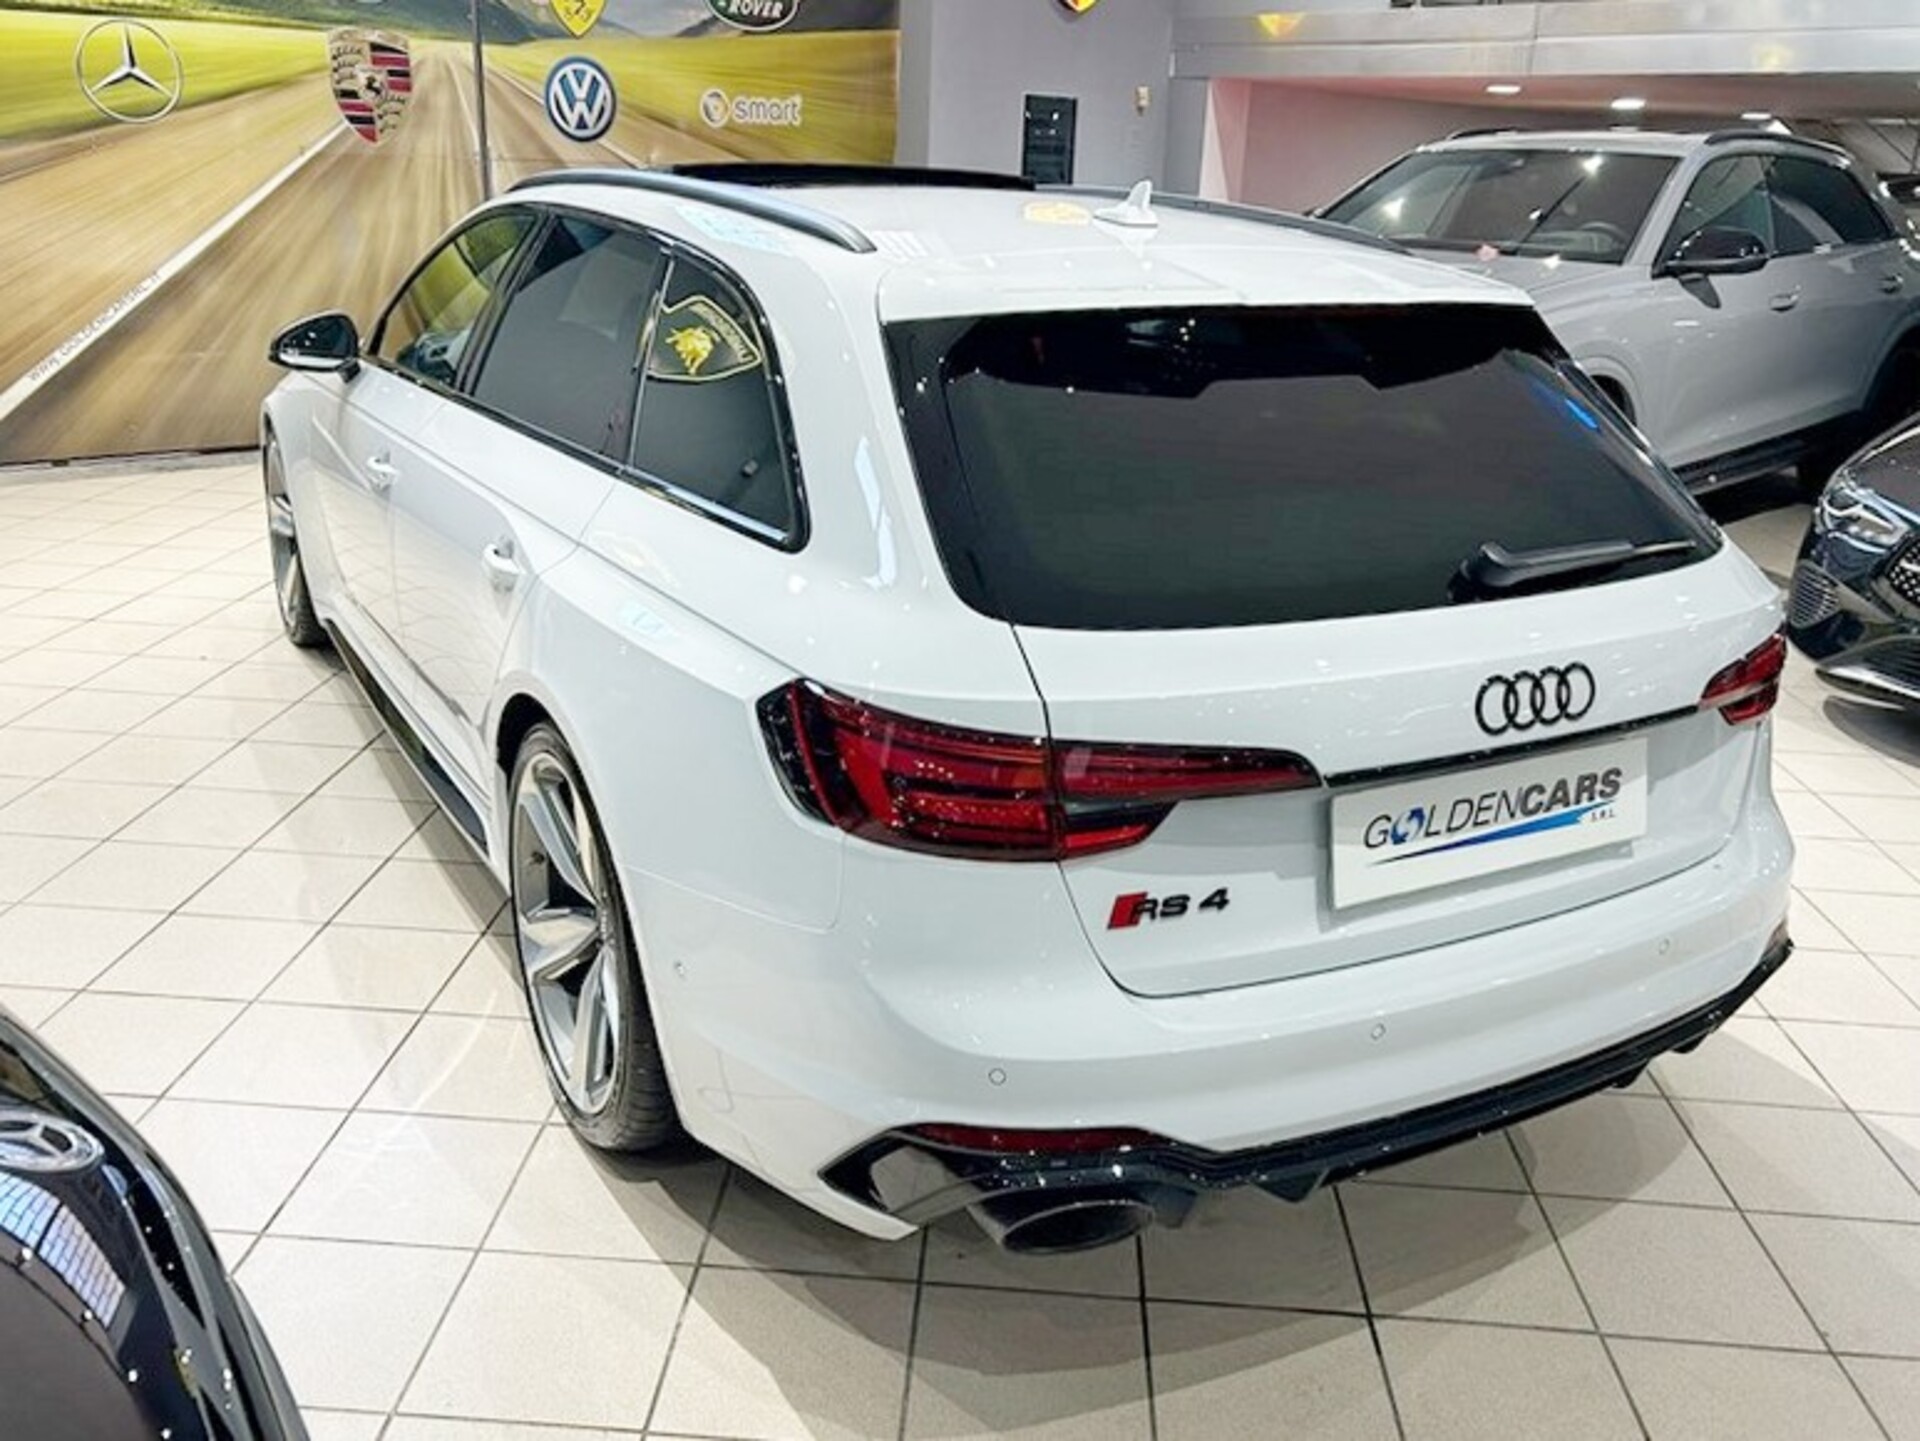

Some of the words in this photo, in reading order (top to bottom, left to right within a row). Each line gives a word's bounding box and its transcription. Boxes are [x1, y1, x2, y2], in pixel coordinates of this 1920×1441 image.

[733, 96, 801, 124] smart
[1364, 767, 1622, 849] GOLDENCARS
[1129, 894, 1191, 922] RS
[1198, 887, 1230, 911] 4
